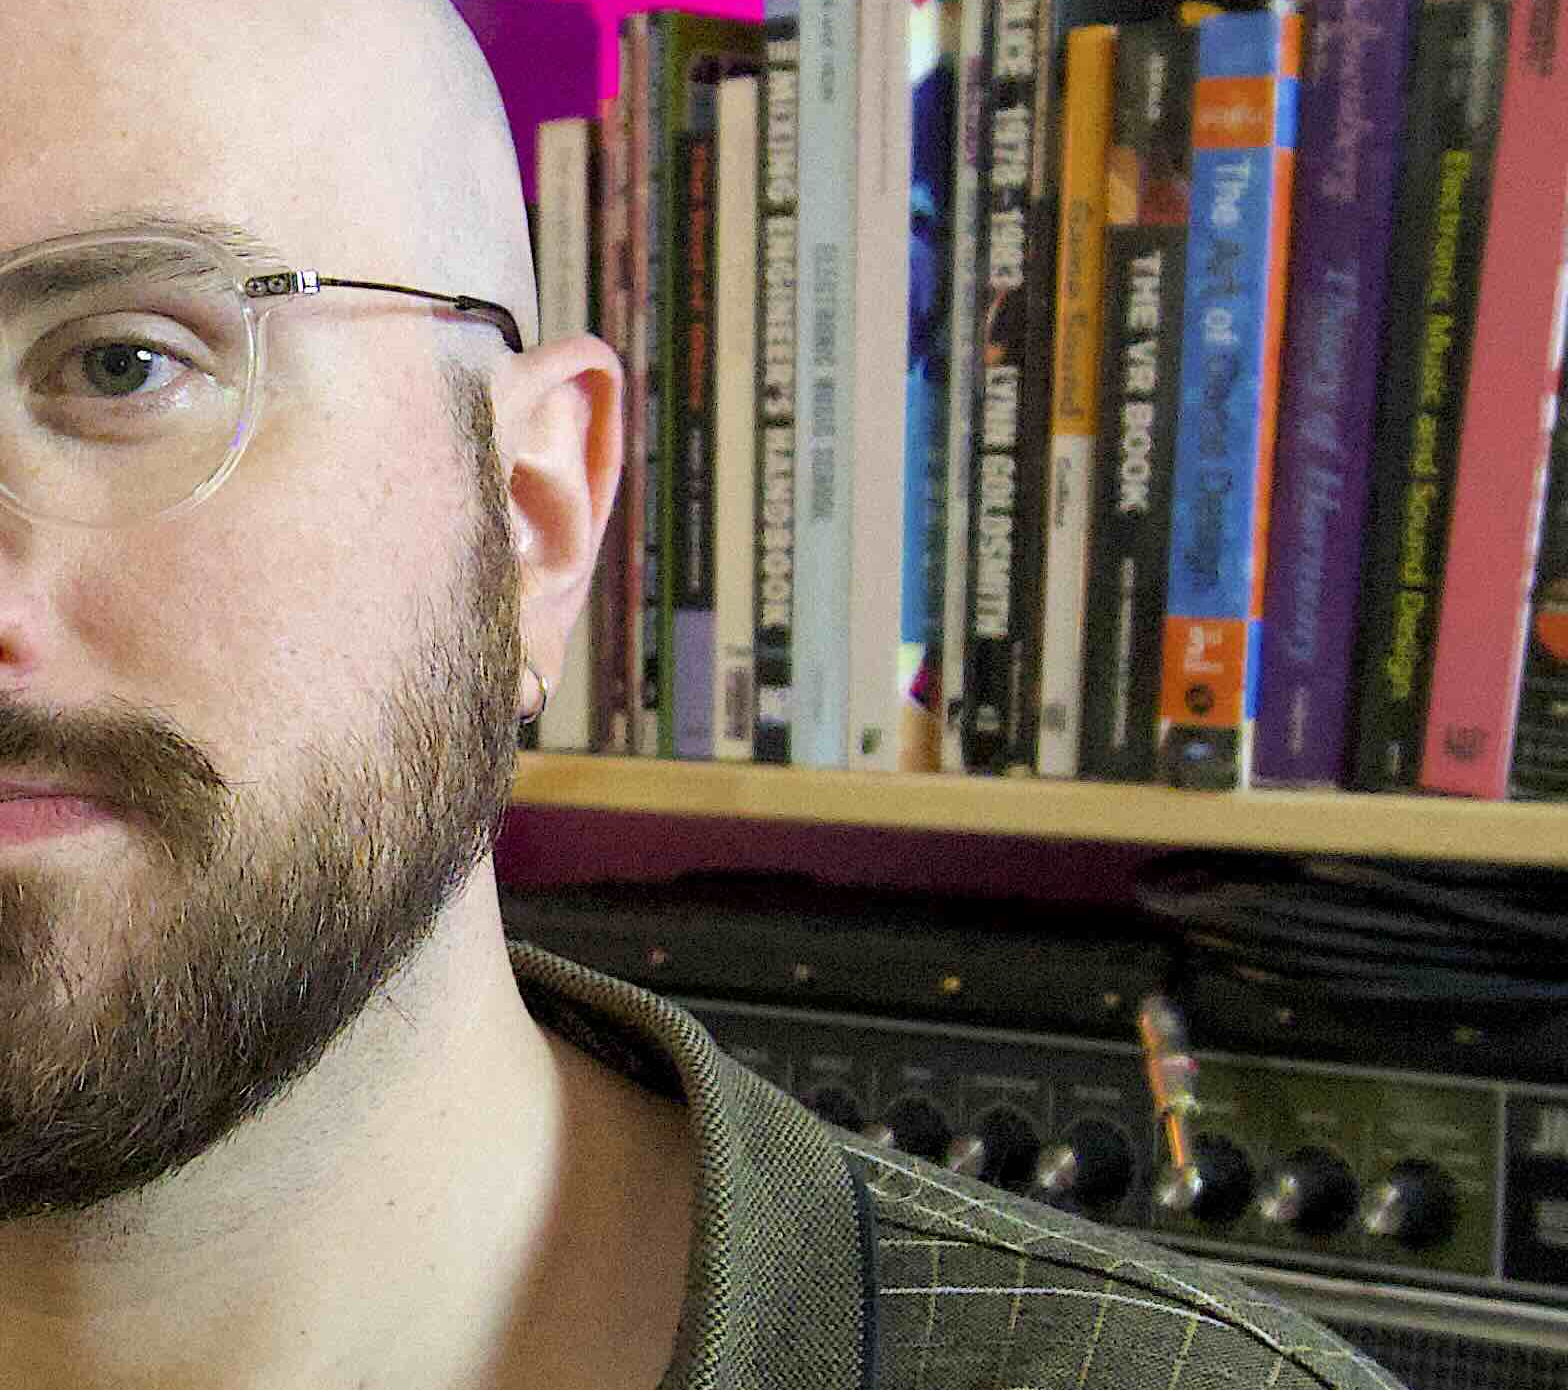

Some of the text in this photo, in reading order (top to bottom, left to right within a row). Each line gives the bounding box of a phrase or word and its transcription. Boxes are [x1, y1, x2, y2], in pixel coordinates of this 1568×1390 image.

[765, 71, 797, 204] MIXING
[1209, 160, 1253, 229] The
[1428, 148, 1471, 302] Electronic
[763, 217, 796, 416] ENGINEER'S
[1202, 307, 1241, 349] of
[1417, 313, 1456, 406] Music
[983, 364, 1019, 452] LYNN
[1118, 252, 1163, 513] THE VR BOOK
[1410, 414, 1446, 474] and
[761, 427, 794, 629] HANDBOOK
[975, 454, 1016, 638] GOLDSMITH
[1399, 484, 1442, 583] Sound
[1386, 591, 1430, 701] Design
